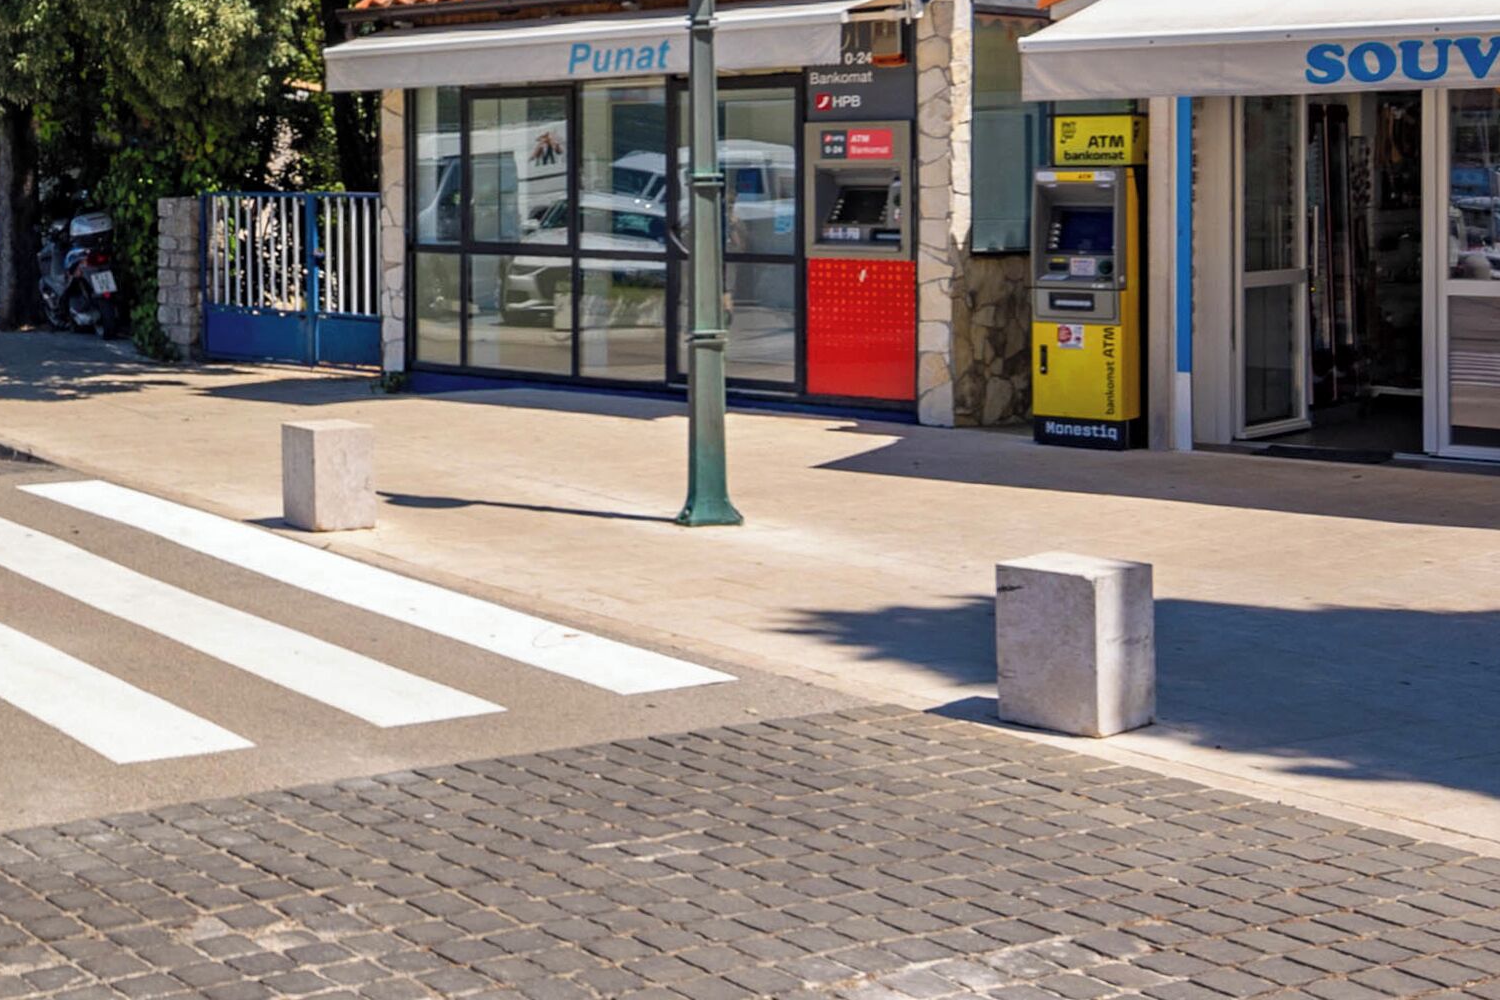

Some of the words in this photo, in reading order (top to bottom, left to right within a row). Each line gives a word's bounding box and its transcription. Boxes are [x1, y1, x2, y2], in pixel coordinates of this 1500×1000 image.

[568, 39, 670, 74] Punat
[844, 51, 872, 65] 0-24
[1305, 36, 1500, 84] SOUV
[809, 70, 873, 85] Bankomat
[832, 95, 861, 108] HPB
[1088, 135, 1124, 149] ATM
[1063, 150, 1125, 160] bankomat
[1103, 326, 1115, 358] ATM
[1104, 361, 1115, 415] bankomat
[1045, 421, 1117, 441] Monestiq
